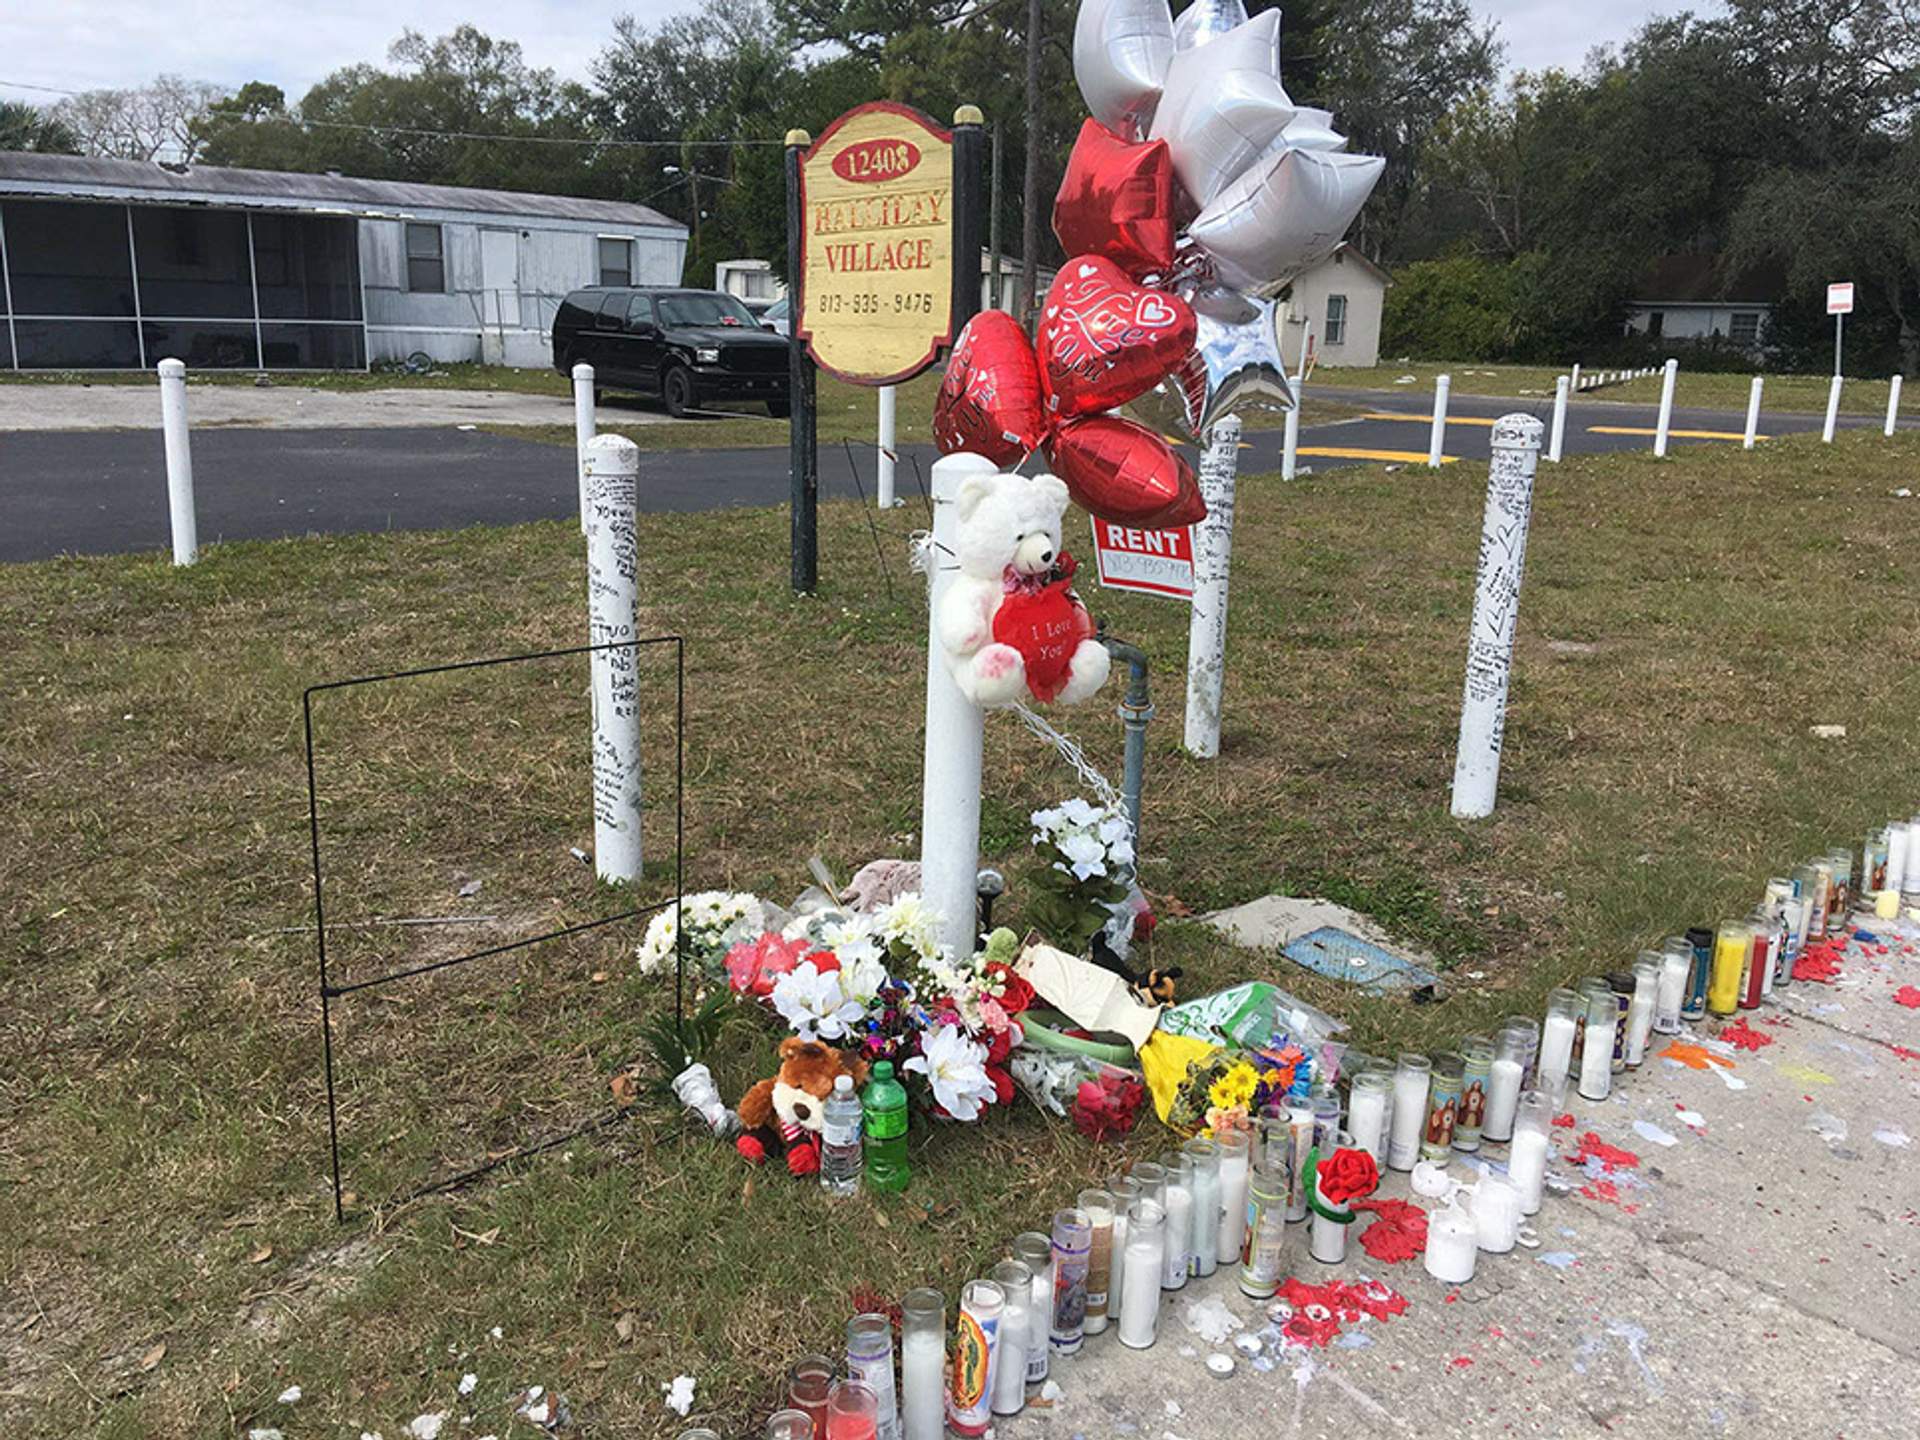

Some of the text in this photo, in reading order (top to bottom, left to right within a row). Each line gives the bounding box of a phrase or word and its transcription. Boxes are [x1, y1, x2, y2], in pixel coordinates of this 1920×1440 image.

[847, 146, 909, 177] 12408
[825, 239, 932, 273] VILLAGE
[1060, 293, 1143, 355] Love
[1106, 525, 1180, 556] RENT
[1031, 620, 1071, 640] I Love
[1040, 645, 1063, 660] You
